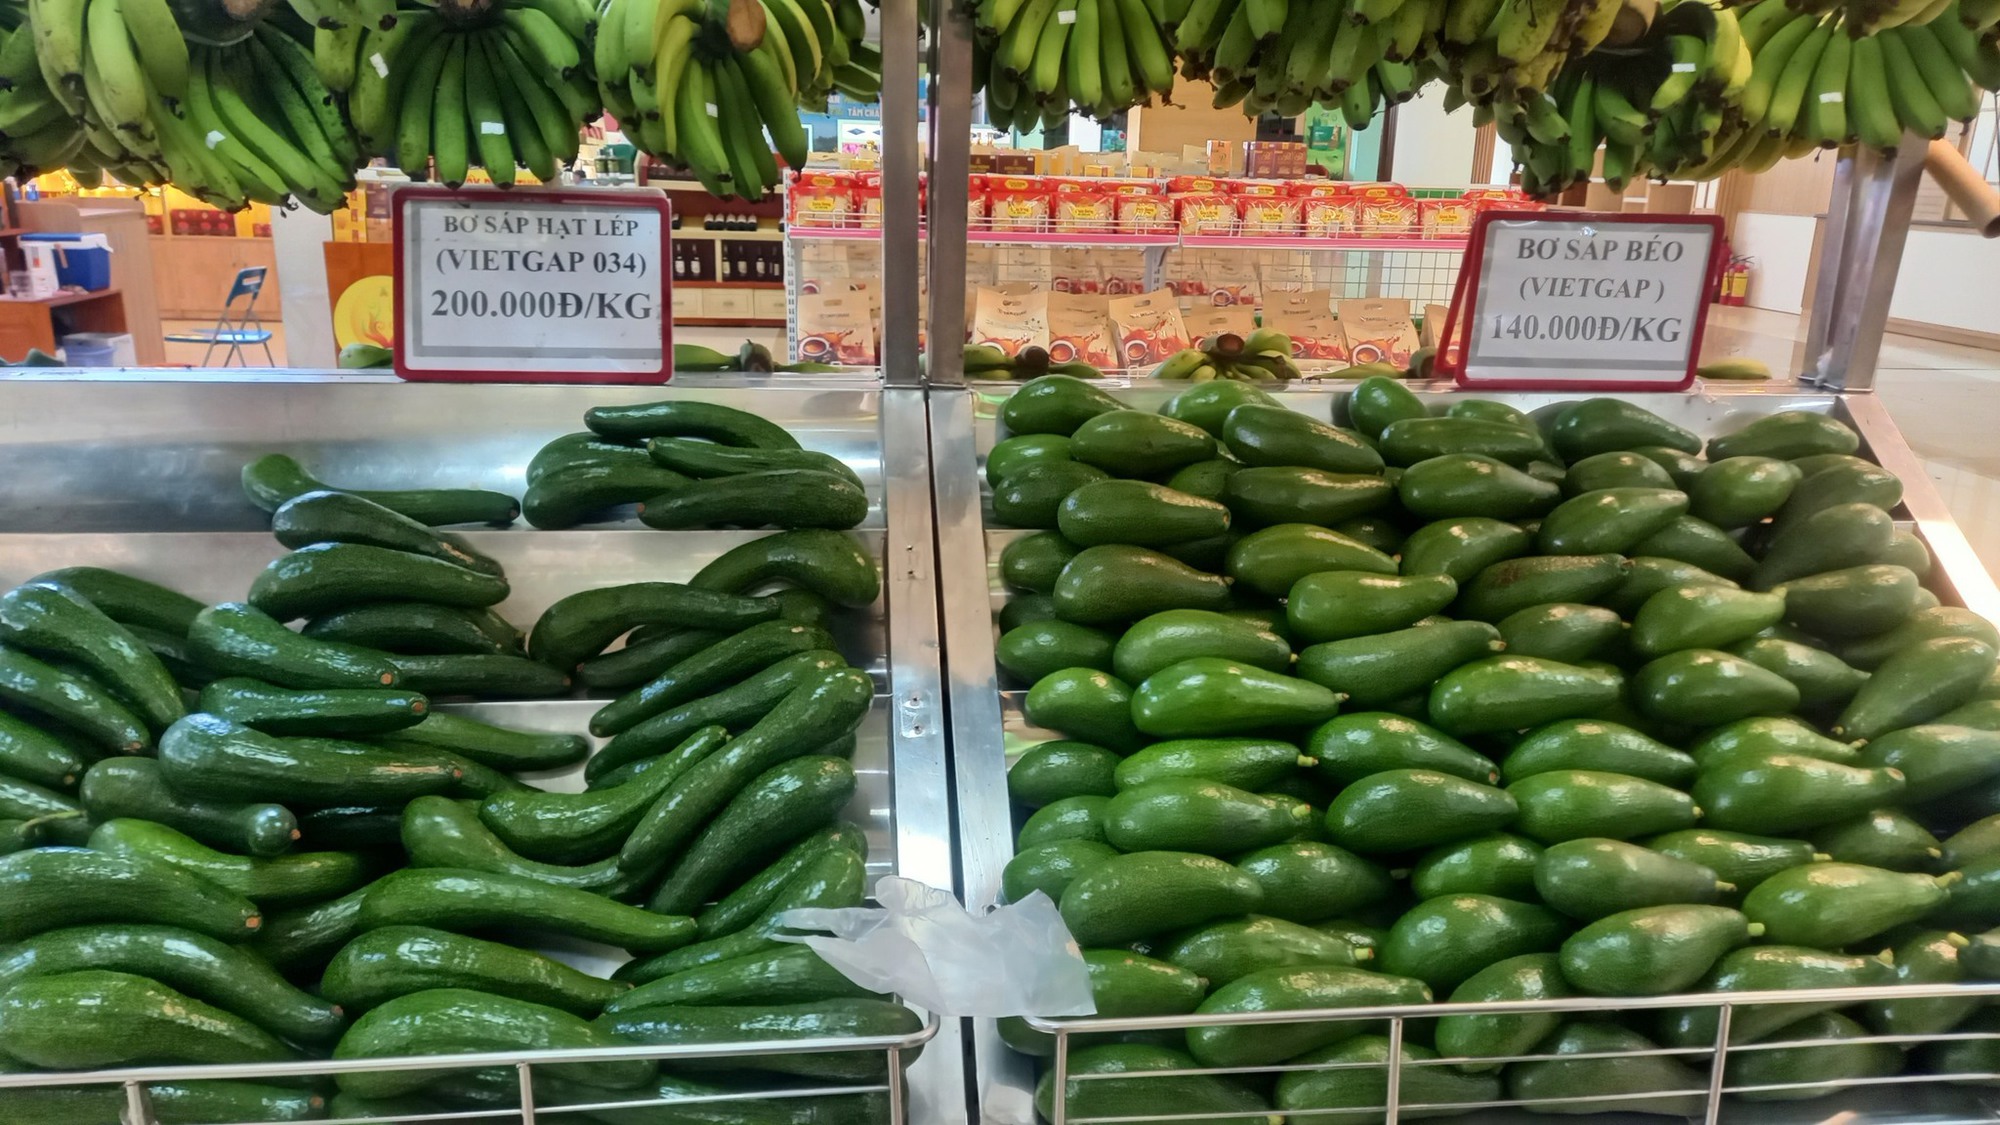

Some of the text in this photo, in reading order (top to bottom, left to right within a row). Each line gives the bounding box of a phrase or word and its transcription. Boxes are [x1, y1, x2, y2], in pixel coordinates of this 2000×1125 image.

[443, 211, 639, 240] BƠ SÁP HẠT LÉP
[1516, 234, 1684, 262] BƠ SÁP BÉO
[436, 248, 647, 279] (VIETGAP 034)
[431, 289, 652, 320] 200.000Đ/KG
[1491, 313, 1682, 343] 140.000Đ/KG
